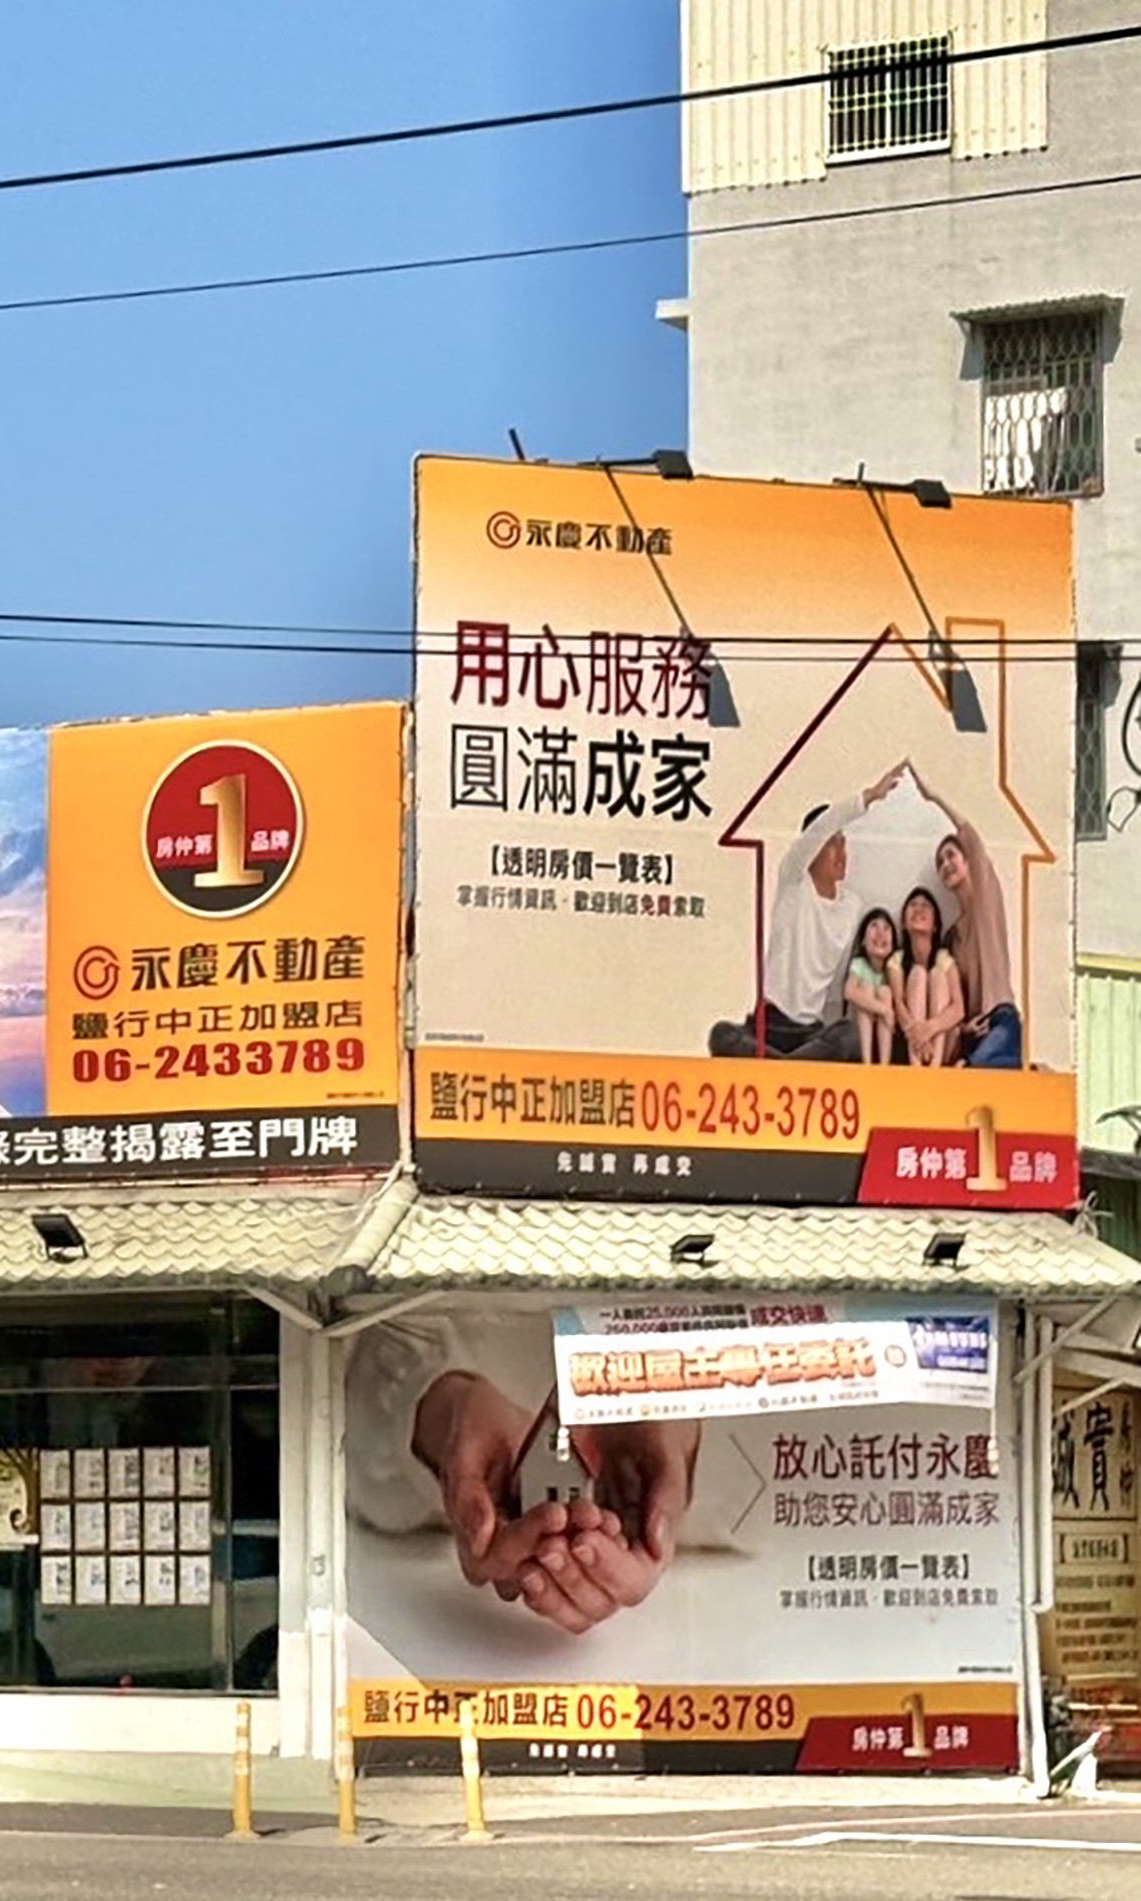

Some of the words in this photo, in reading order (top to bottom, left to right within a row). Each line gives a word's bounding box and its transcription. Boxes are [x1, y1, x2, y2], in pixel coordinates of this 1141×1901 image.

[525, 518, 672, 556] 永慶不動產
[449, 619, 712, 722] 用心服務
[449, 723, 714, 821] 圓滿成家
[131, 935, 365, 992] 永慶不動產
[72, 1000, 363, 1040] 鹽行中正加盟店
[72, 1037, 366, 1083] 06-2433789
[429, 1070, 635, 1130] 鹽行中正加盟店
[641, 1079, 860, 1141] 06-243-3789
[772, 1433, 999, 1480] 放心託付永慶
[773, 1491, 1000, 1527] 助您安心圓滿成家
[577, 1693, 795, 1731] 06-243-3789
